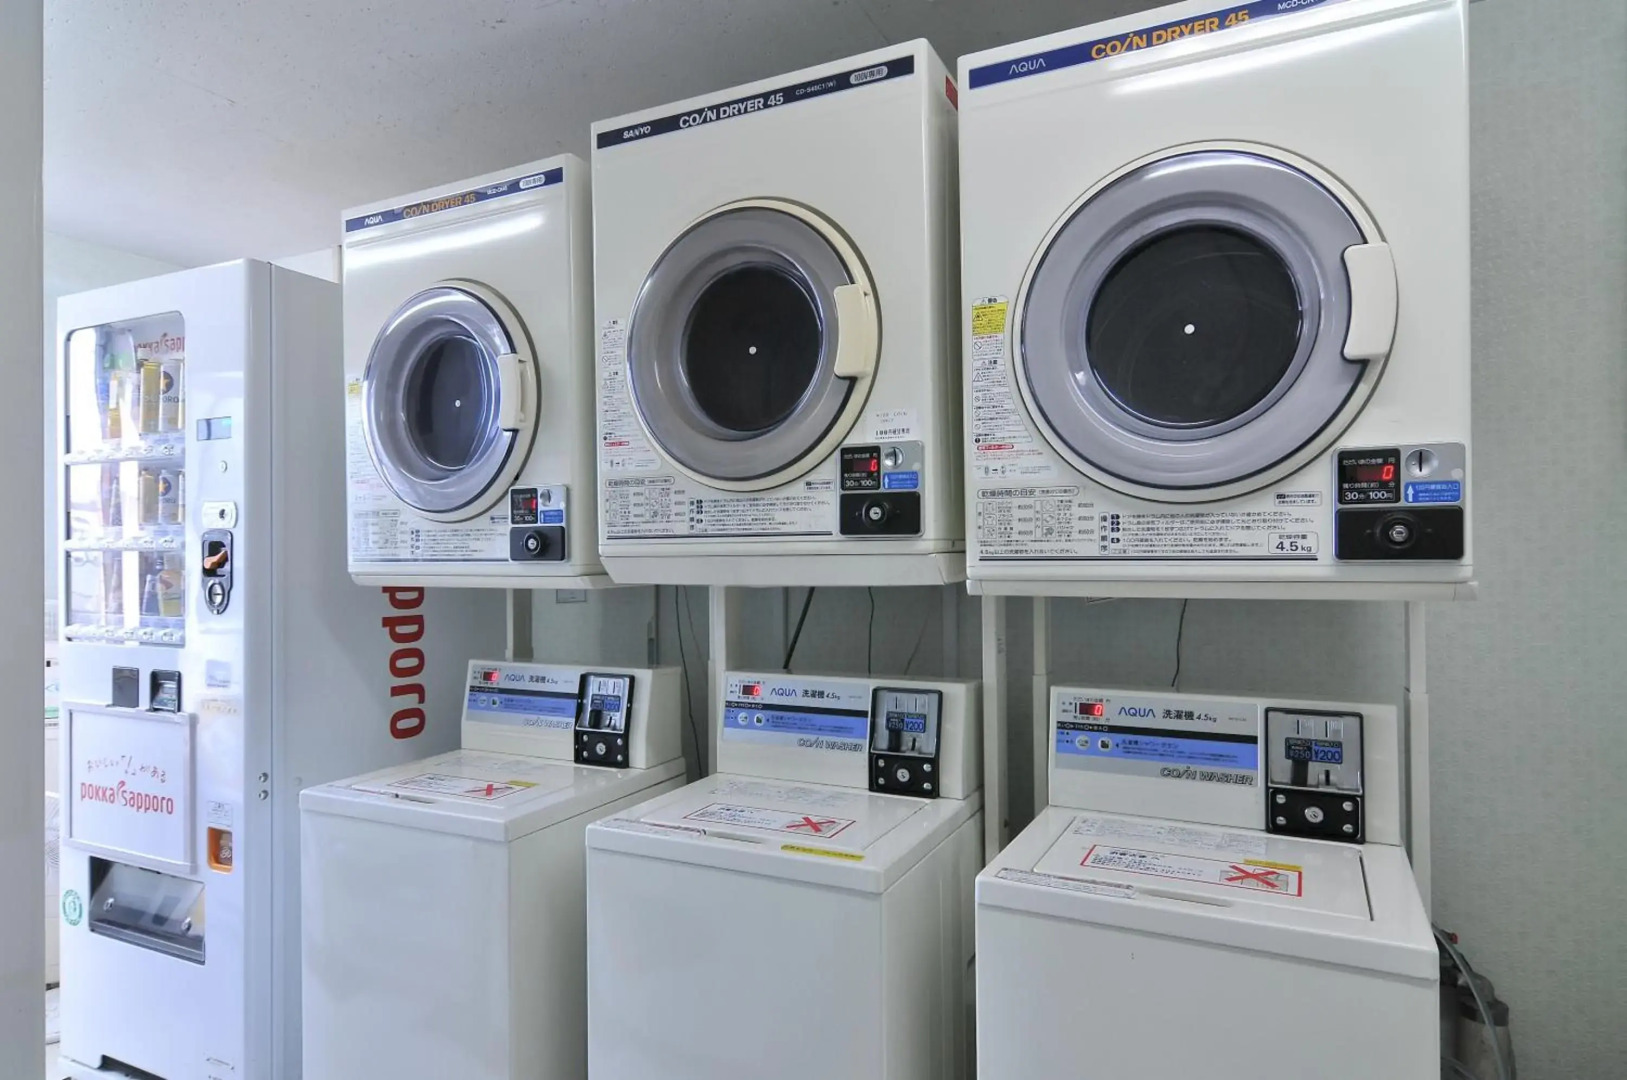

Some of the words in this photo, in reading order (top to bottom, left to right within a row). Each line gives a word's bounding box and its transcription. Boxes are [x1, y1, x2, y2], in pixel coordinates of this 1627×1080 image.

[1153, 16, 1220, 46] DRYER
[1224, 9, 1250, 27] 45
[1009, 57, 1046, 74] AQUA
[720, 97, 764, 119] DRYER
[767, 92, 784, 107] 45
[623, 125, 651, 139] SANYO
[430, 196, 463, 213] DRYER
[463, 193, 476, 204] 45
[364, 215, 383, 226] AQUA
[1382, 465, 1395, 480] 0
[1275, 541, 1299, 552] 4.5
[1300, 544, 1313, 553] kg
[504, 673, 526, 682] AQUA
[753, 684, 760, 696] 0
[770, 687, 798, 698] AQUA
[801, 689, 826, 699] 洗濯機
[826, 691, 841, 701] 4.5kg
[1094, 703, 1103, 715] 0
[1118, 706, 1156, 719] AQUA
[1162, 708, 1195, 721] 洗濯機
[1196, 713, 1218, 723] 4.5kg
[905, 720, 924, 731] ¥200
[1313, 748, 1341, 762] ¥200
[1199, 770, 1254, 786] WASHER
[80, 782, 116, 804] pokka
[121, 789, 174, 815] sapporo
